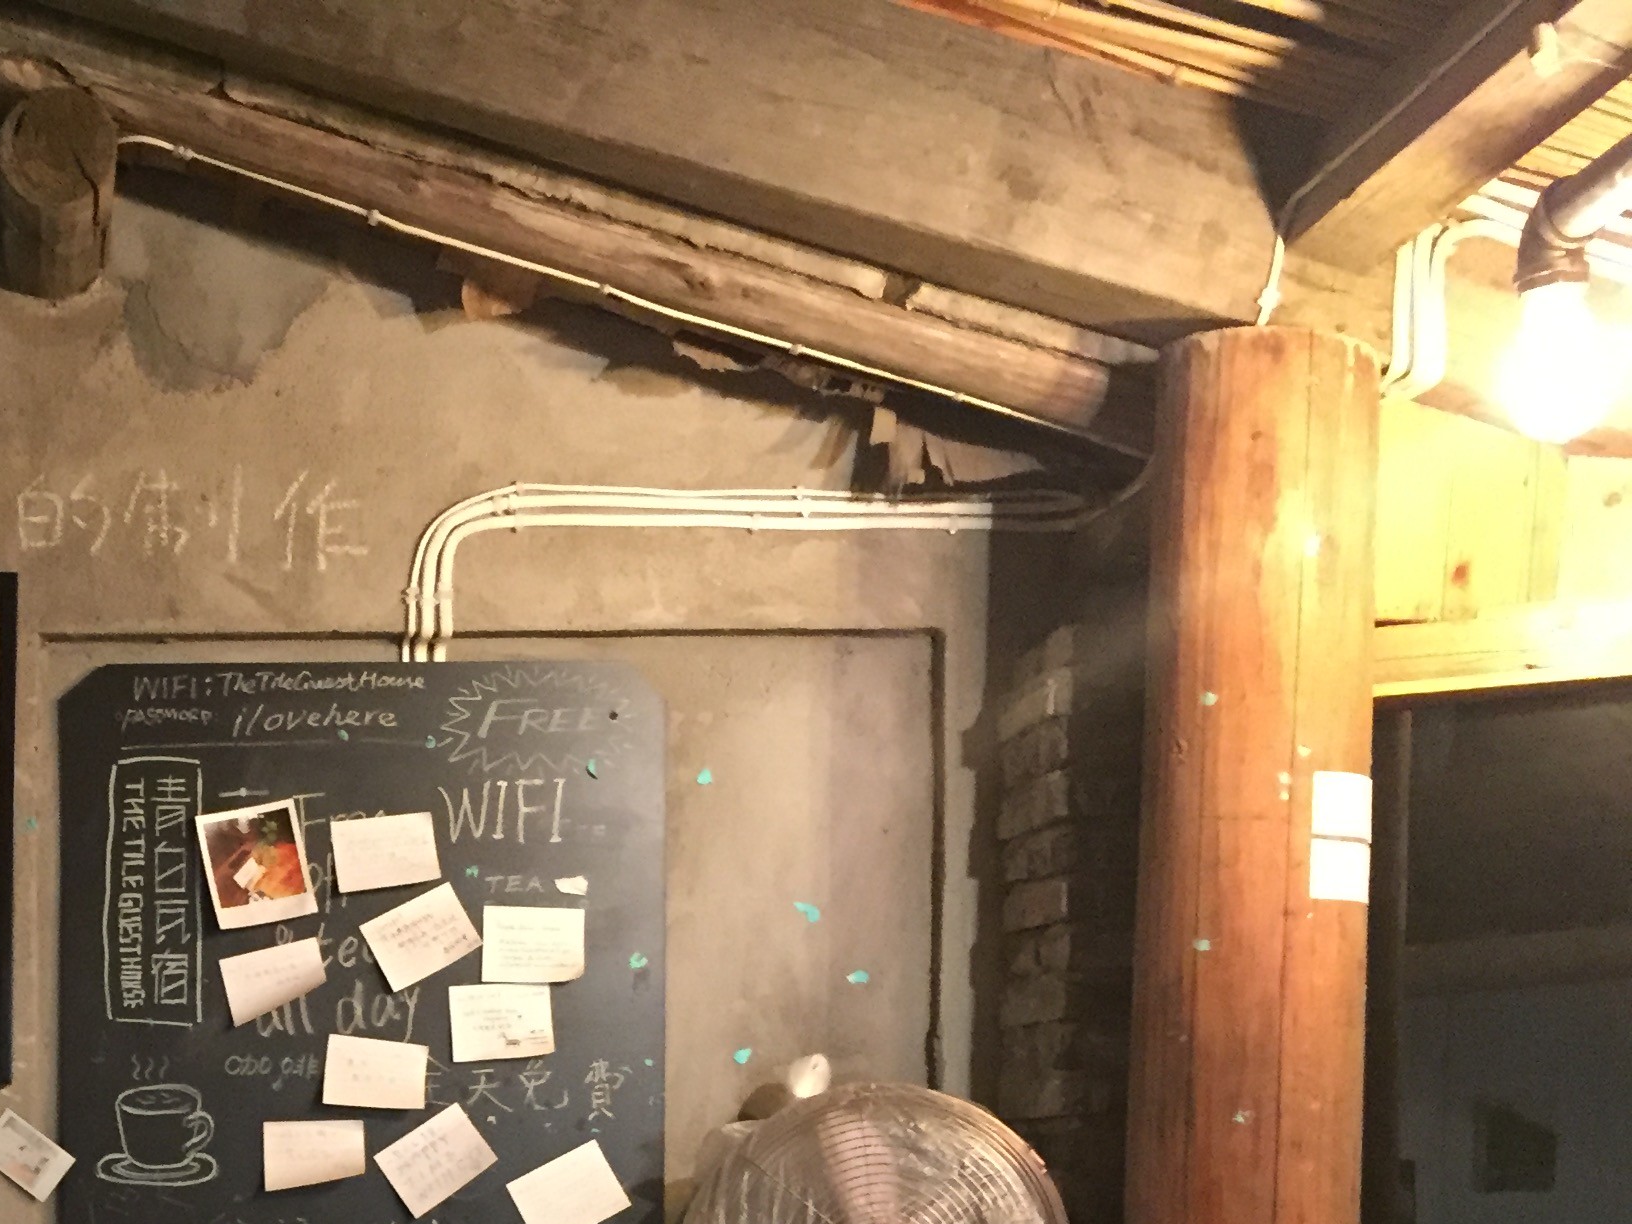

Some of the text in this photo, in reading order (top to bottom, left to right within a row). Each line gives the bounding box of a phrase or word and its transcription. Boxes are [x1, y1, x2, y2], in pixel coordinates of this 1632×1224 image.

[477, 698, 599, 739] FREE
[122, 777, 145, 832] THE
[437, 778, 566, 844] WIFI
[121, 834, 145, 888] TILE
[485, 875, 544, 894] TEA
[337, 979, 420, 1044] day
